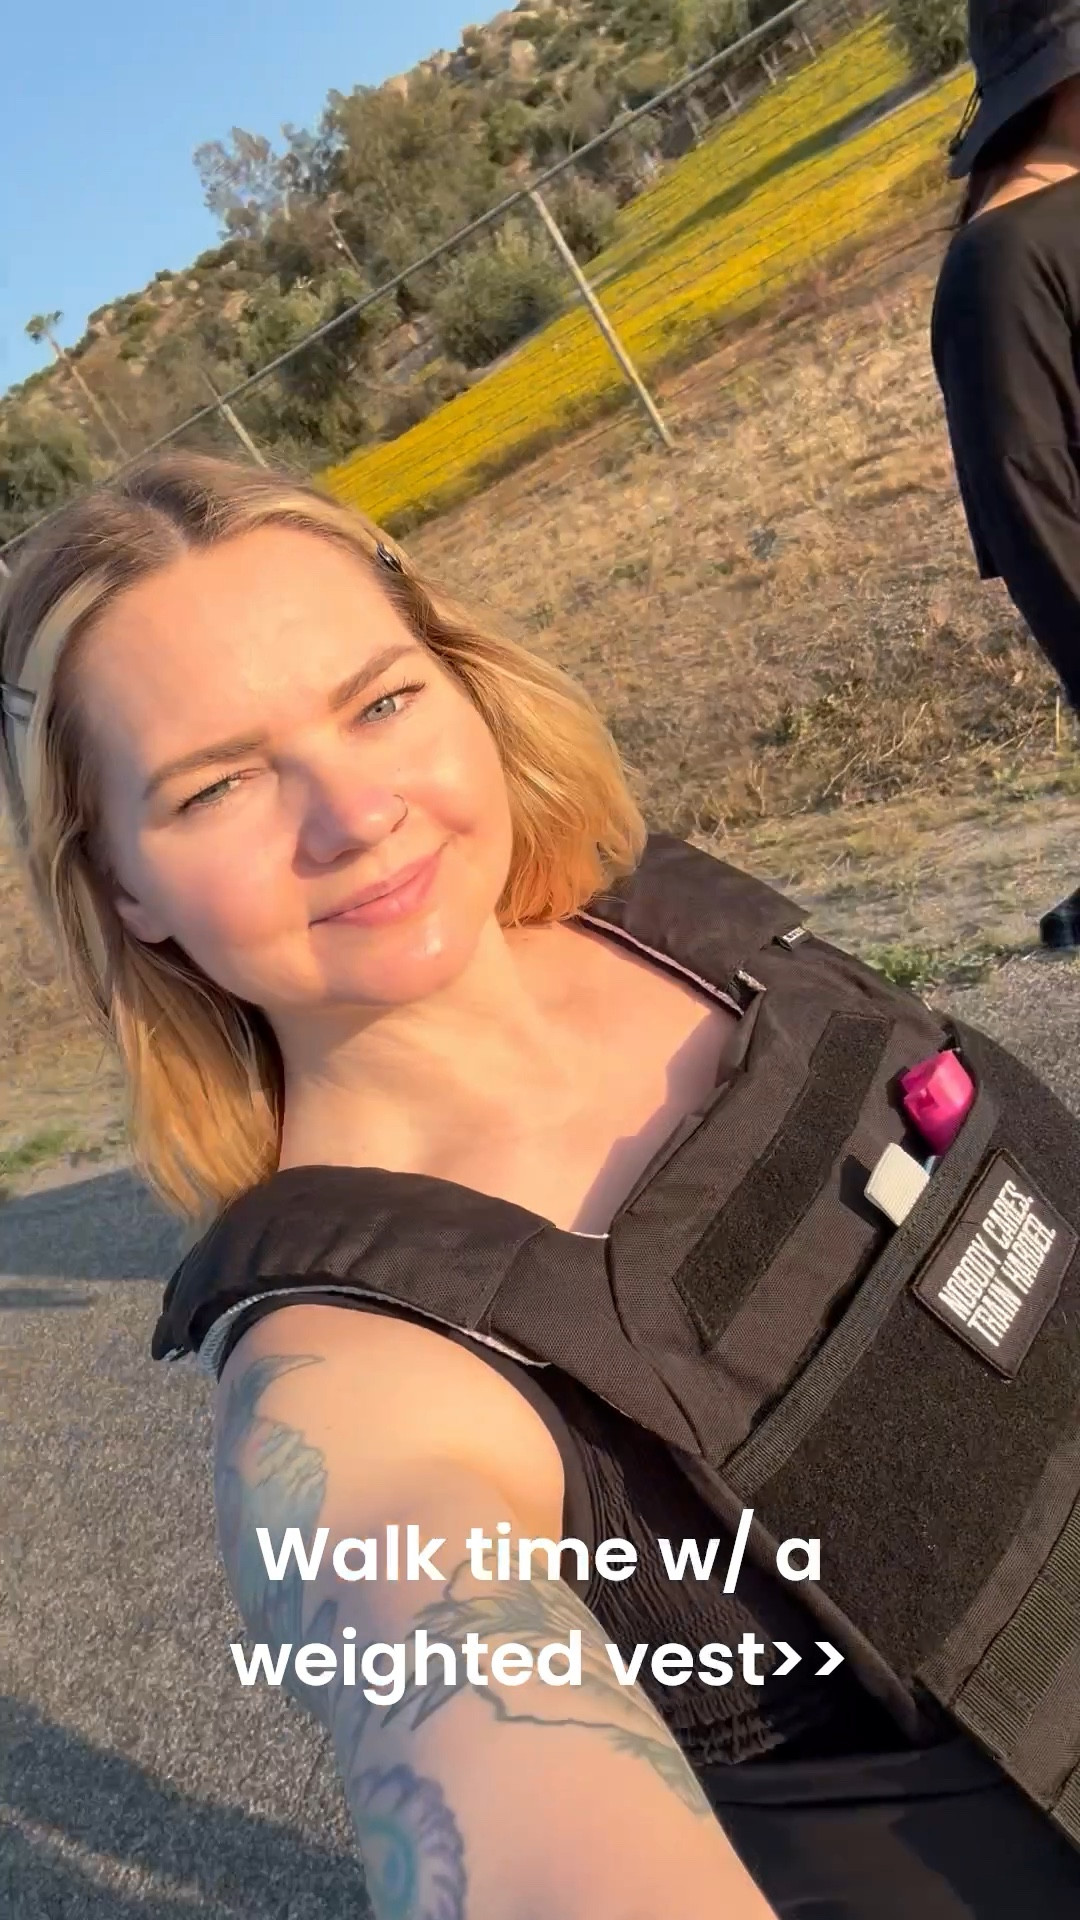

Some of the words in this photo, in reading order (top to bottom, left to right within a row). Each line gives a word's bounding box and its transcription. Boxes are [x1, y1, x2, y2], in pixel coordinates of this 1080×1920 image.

[937, 1232, 1001, 1322] NOBODY
[982, 1179, 1034, 1250] CARES.
[966, 1276, 1023, 1347] TRAIN
[1000, 1212, 1057, 1295] HARDER.
